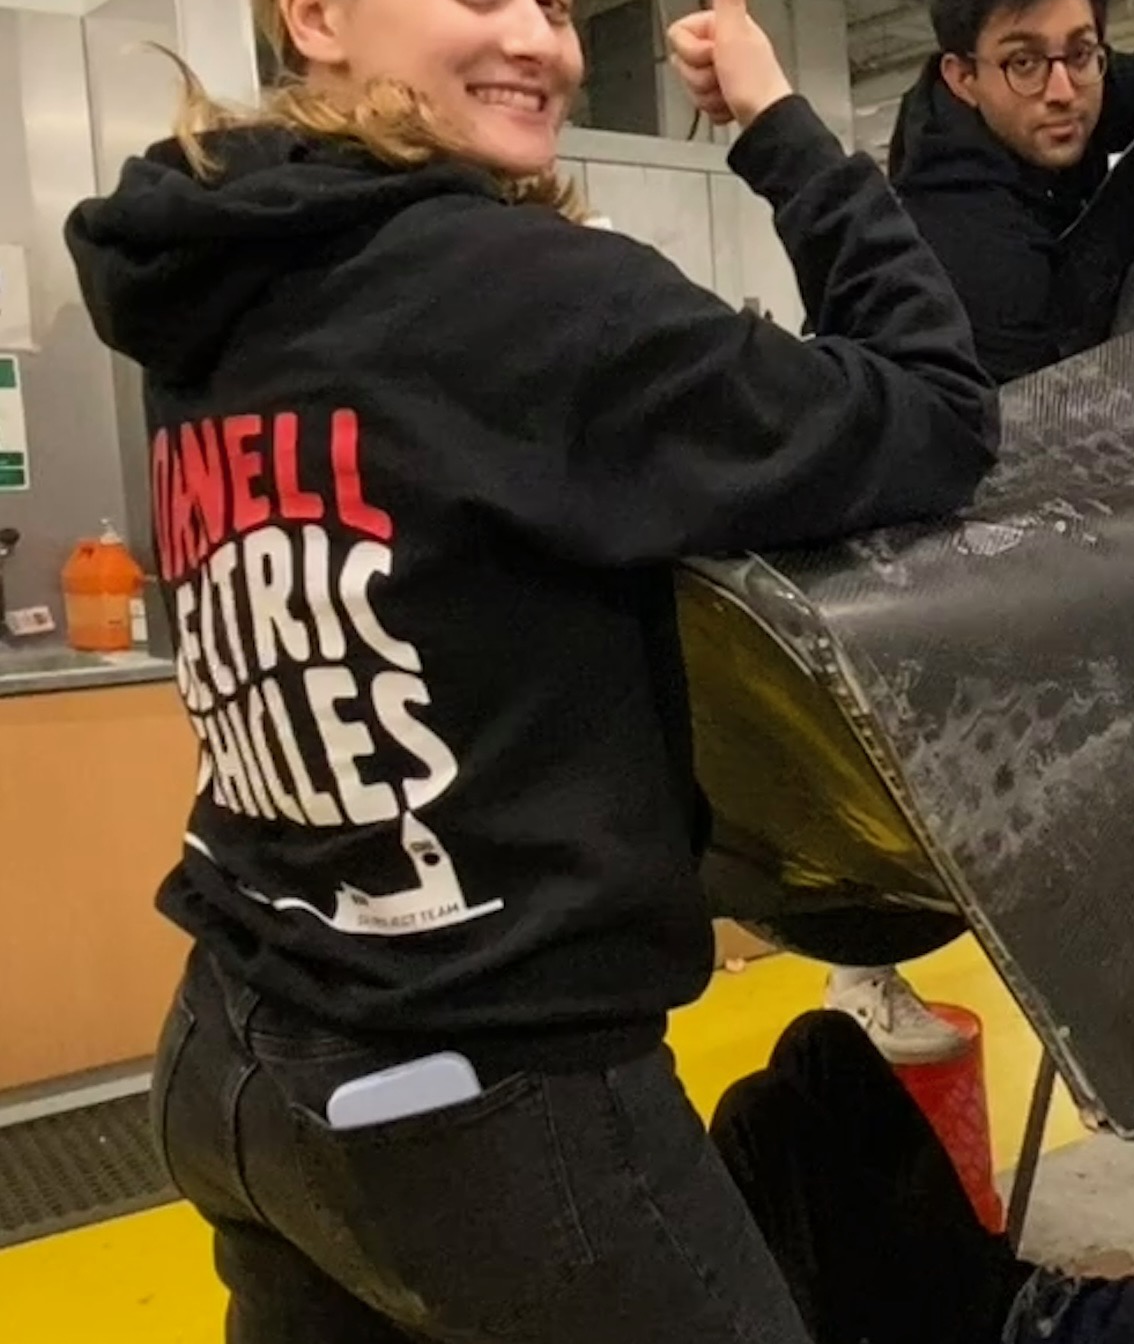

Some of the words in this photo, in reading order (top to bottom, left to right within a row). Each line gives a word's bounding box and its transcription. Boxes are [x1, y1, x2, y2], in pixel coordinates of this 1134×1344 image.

[153, 408, 394, 582] ORNELL
[177, 524, 423, 711] ECTRIC
[192, 666, 459, 826] HICLES
[420, 902, 460, 922] TEAM
